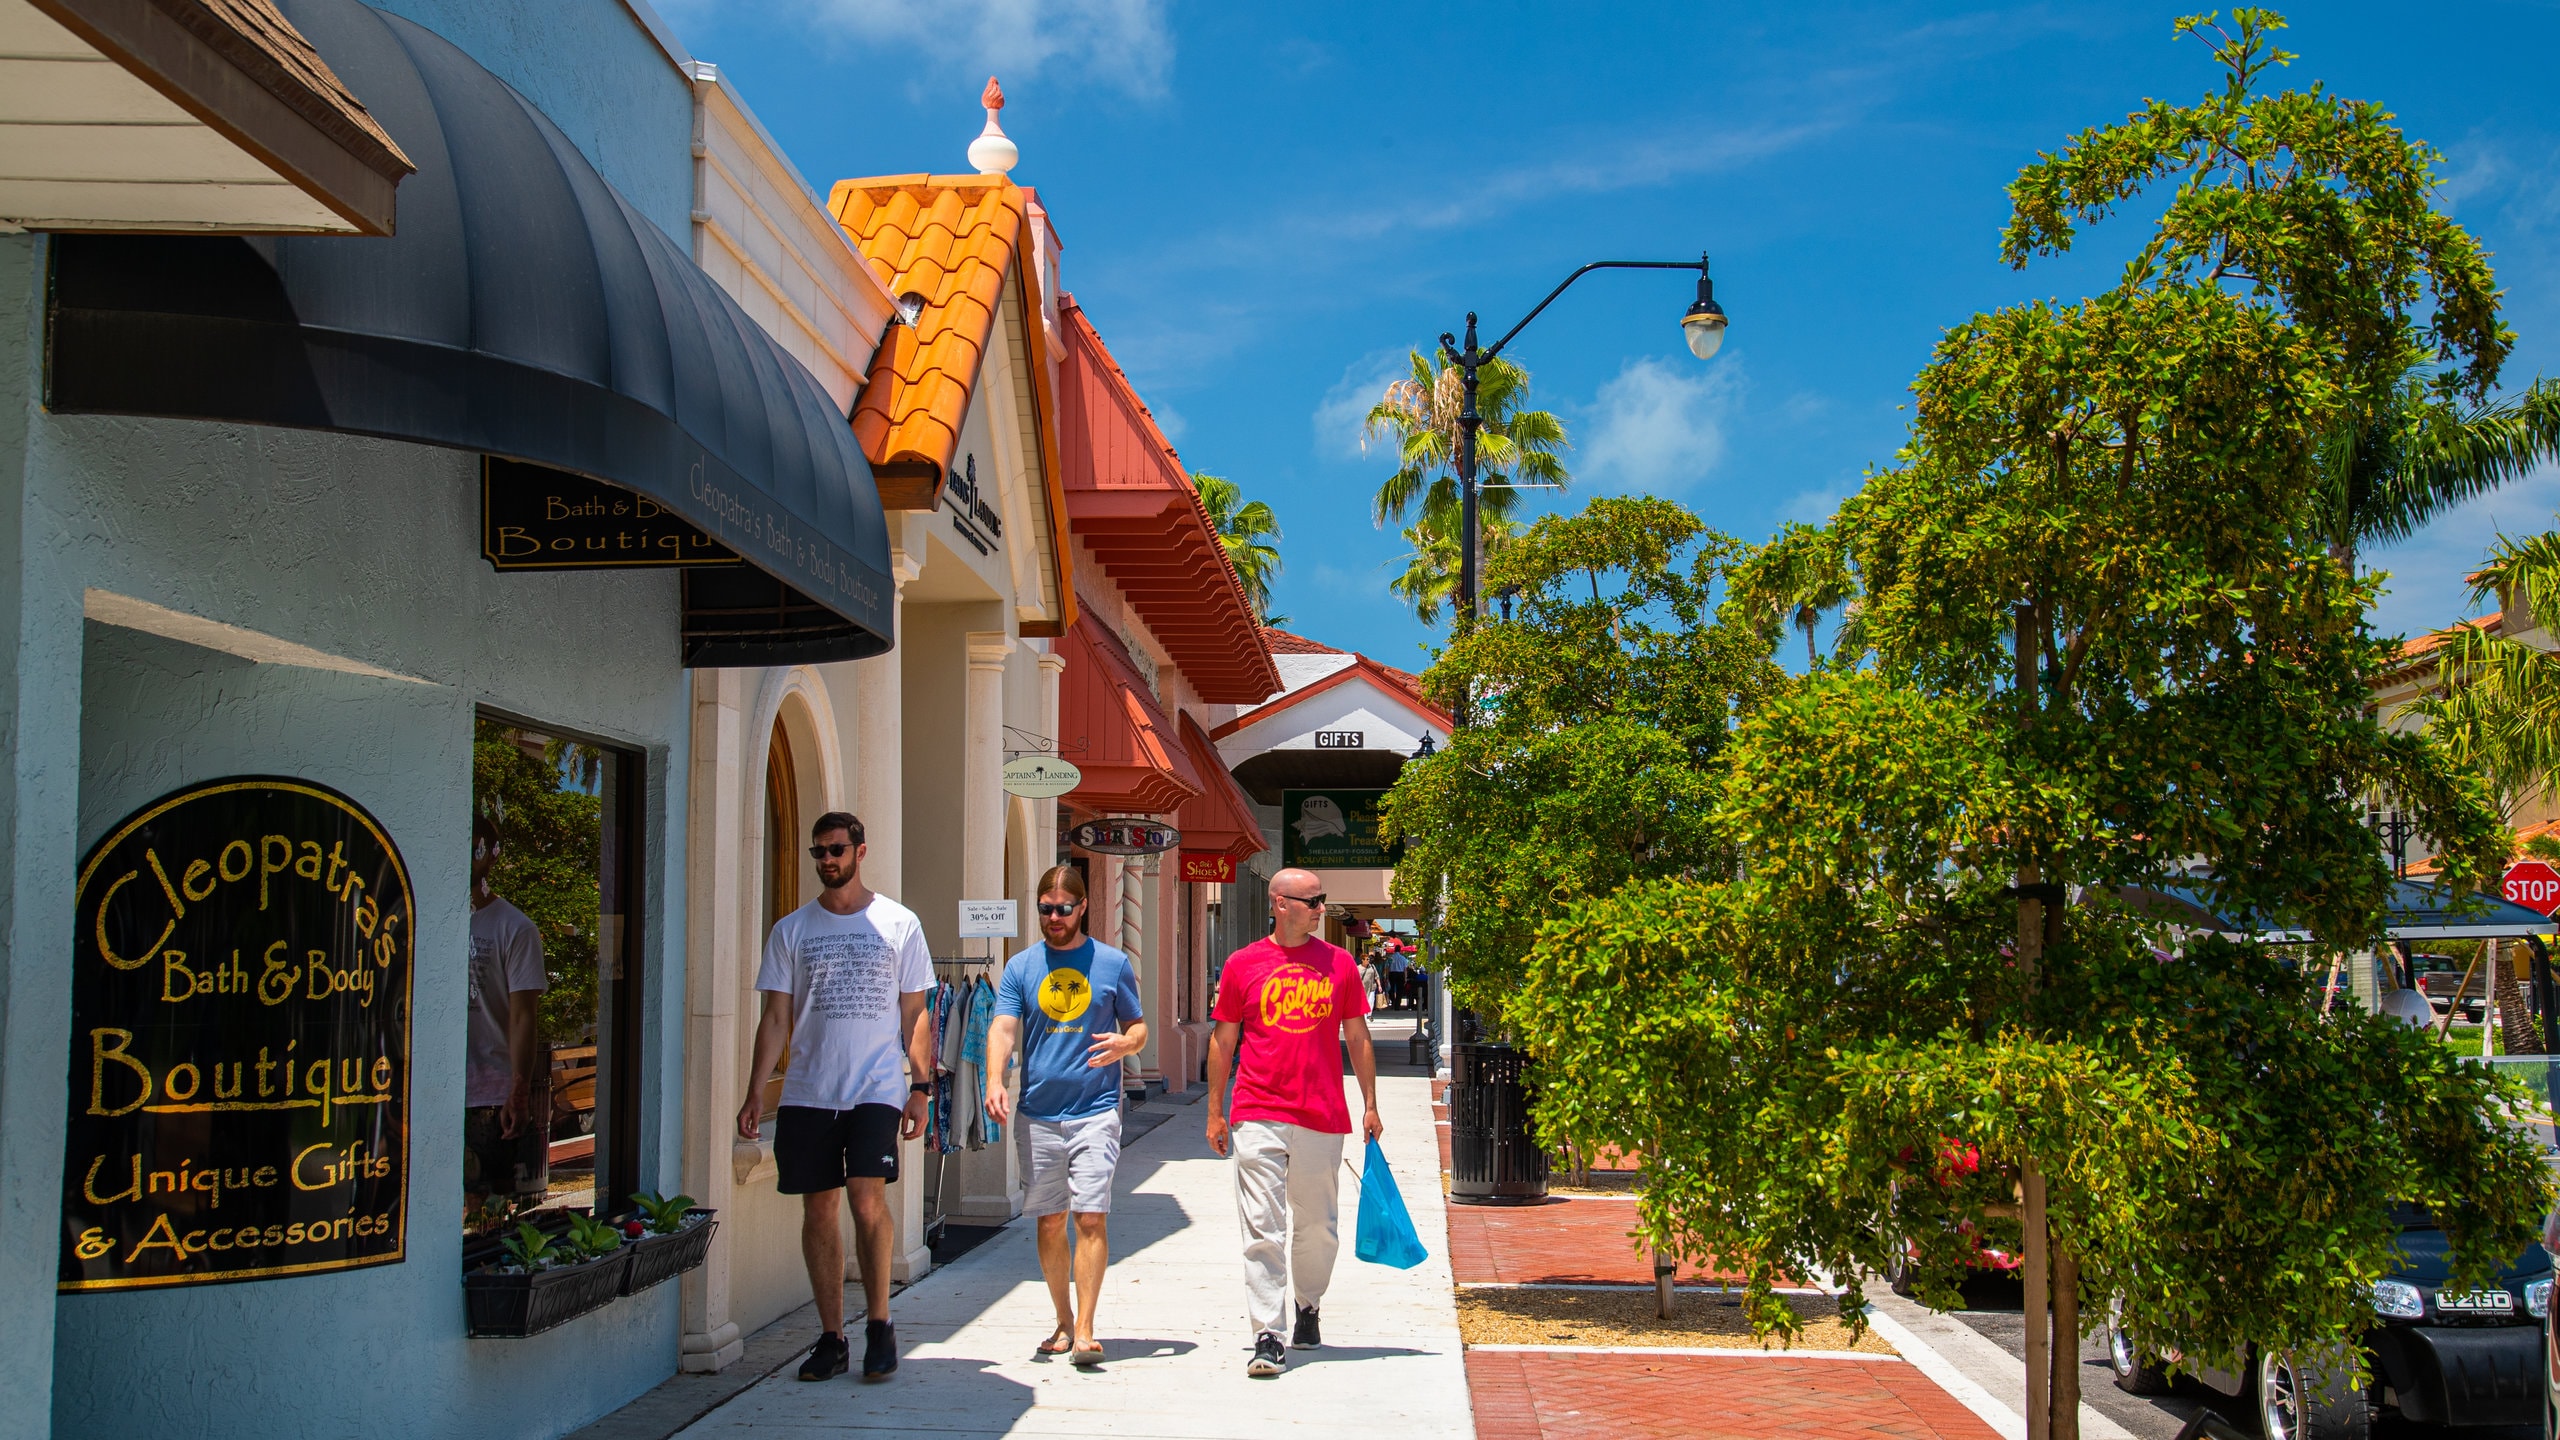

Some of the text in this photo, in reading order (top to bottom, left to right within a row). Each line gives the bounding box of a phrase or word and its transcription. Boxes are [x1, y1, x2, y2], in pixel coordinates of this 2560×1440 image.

[546, 494, 671, 521] Bath & Bo
[497, 526, 713, 560] Boutiqu
[690, 454, 878, 624] Cleopatra's Bath & Body Boutique
[1319, 732, 1360, 747] GIFTS
[1045, 771, 1078, 779] LANDING
[1303, 800, 1329, 809] GIFTS
[1296, 856, 1345, 864] SOUVENIR
[1350, 856, 1391, 864] CENTER
[96, 835, 399, 970] Cleopatra's
[2505, 880, 2559, 902] STOP
[970, 913, 989, 921] 30%
[161, 939, 375, 1008] Bath & Body
[1260, 977, 1334, 1027] Cobra
[1063, 1025, 1083, 1033] Good
[86, 1027, 392, 1128] Boutique
[83, 1140, 391, 1209] Unique Gifts
[73, 1206, 390, 1264] & Accessories
